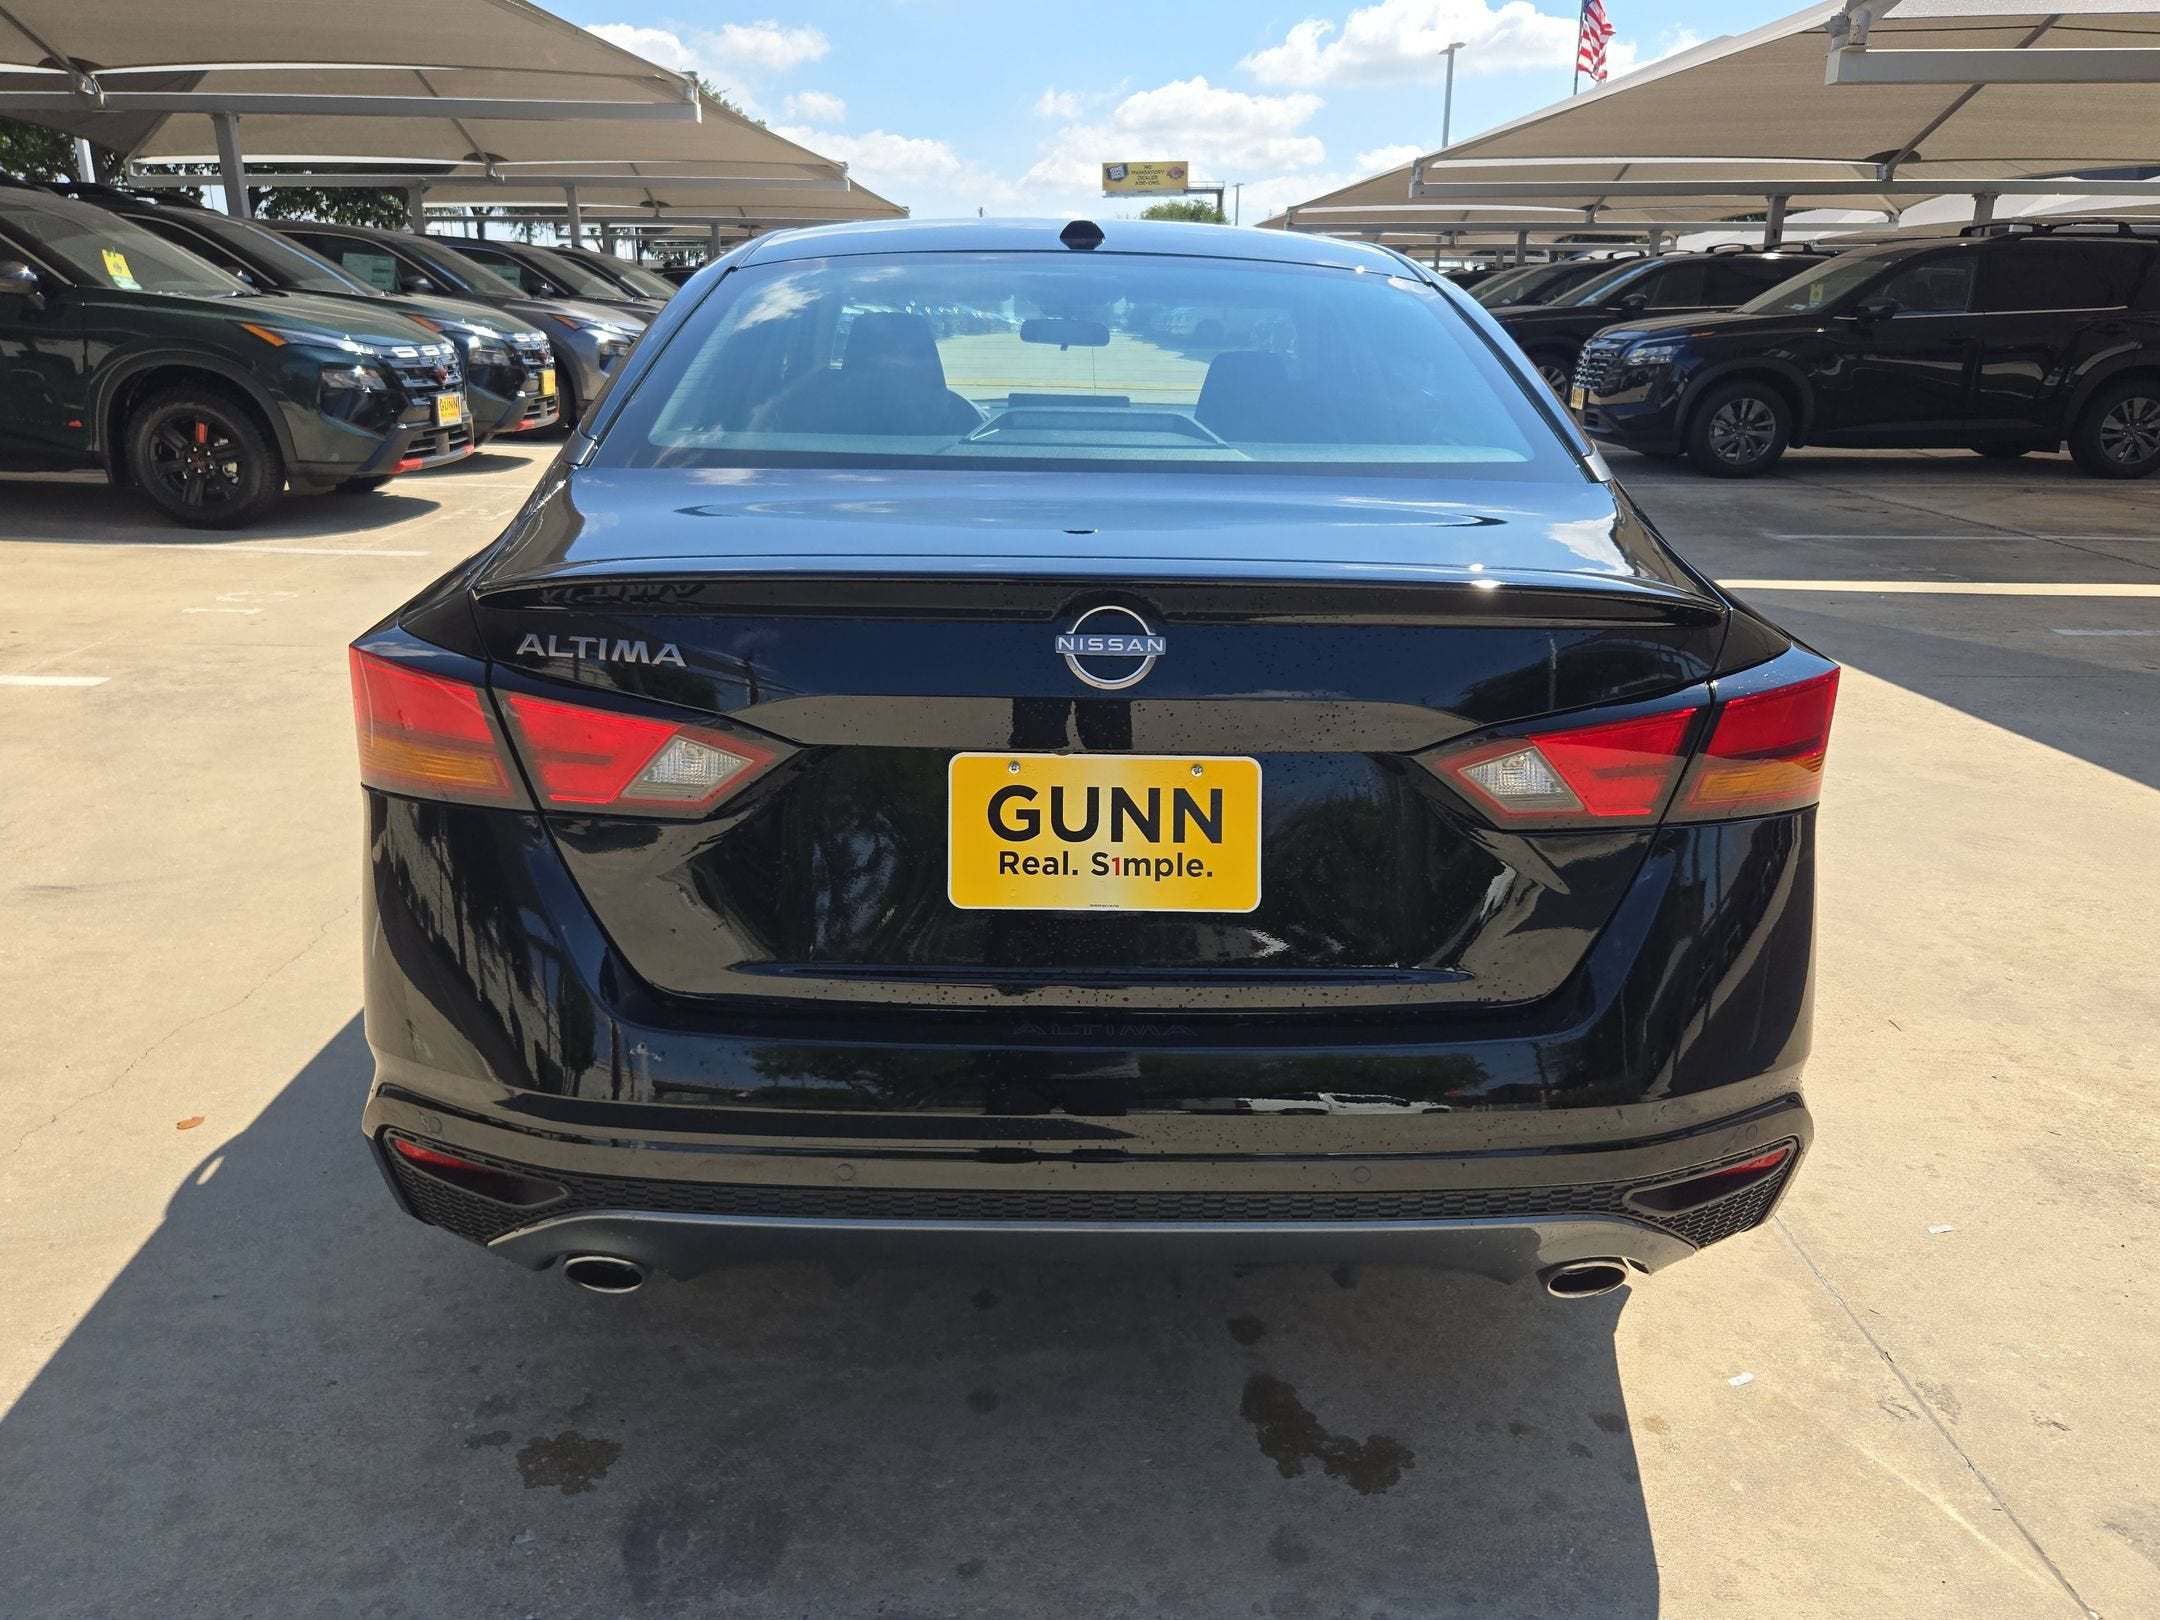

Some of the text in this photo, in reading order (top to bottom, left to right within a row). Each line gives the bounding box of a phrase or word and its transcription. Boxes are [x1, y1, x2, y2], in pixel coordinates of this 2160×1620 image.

[516, 633, 687, 667] ALTIMA
[1058, 636, 1163, 652] NISSAN
[987, 785, 1223, 844] GUNN
[999, 851, 1213, 881] Real. S1mple.
[1012, 1023, 1199, 1037] ALTIMA
